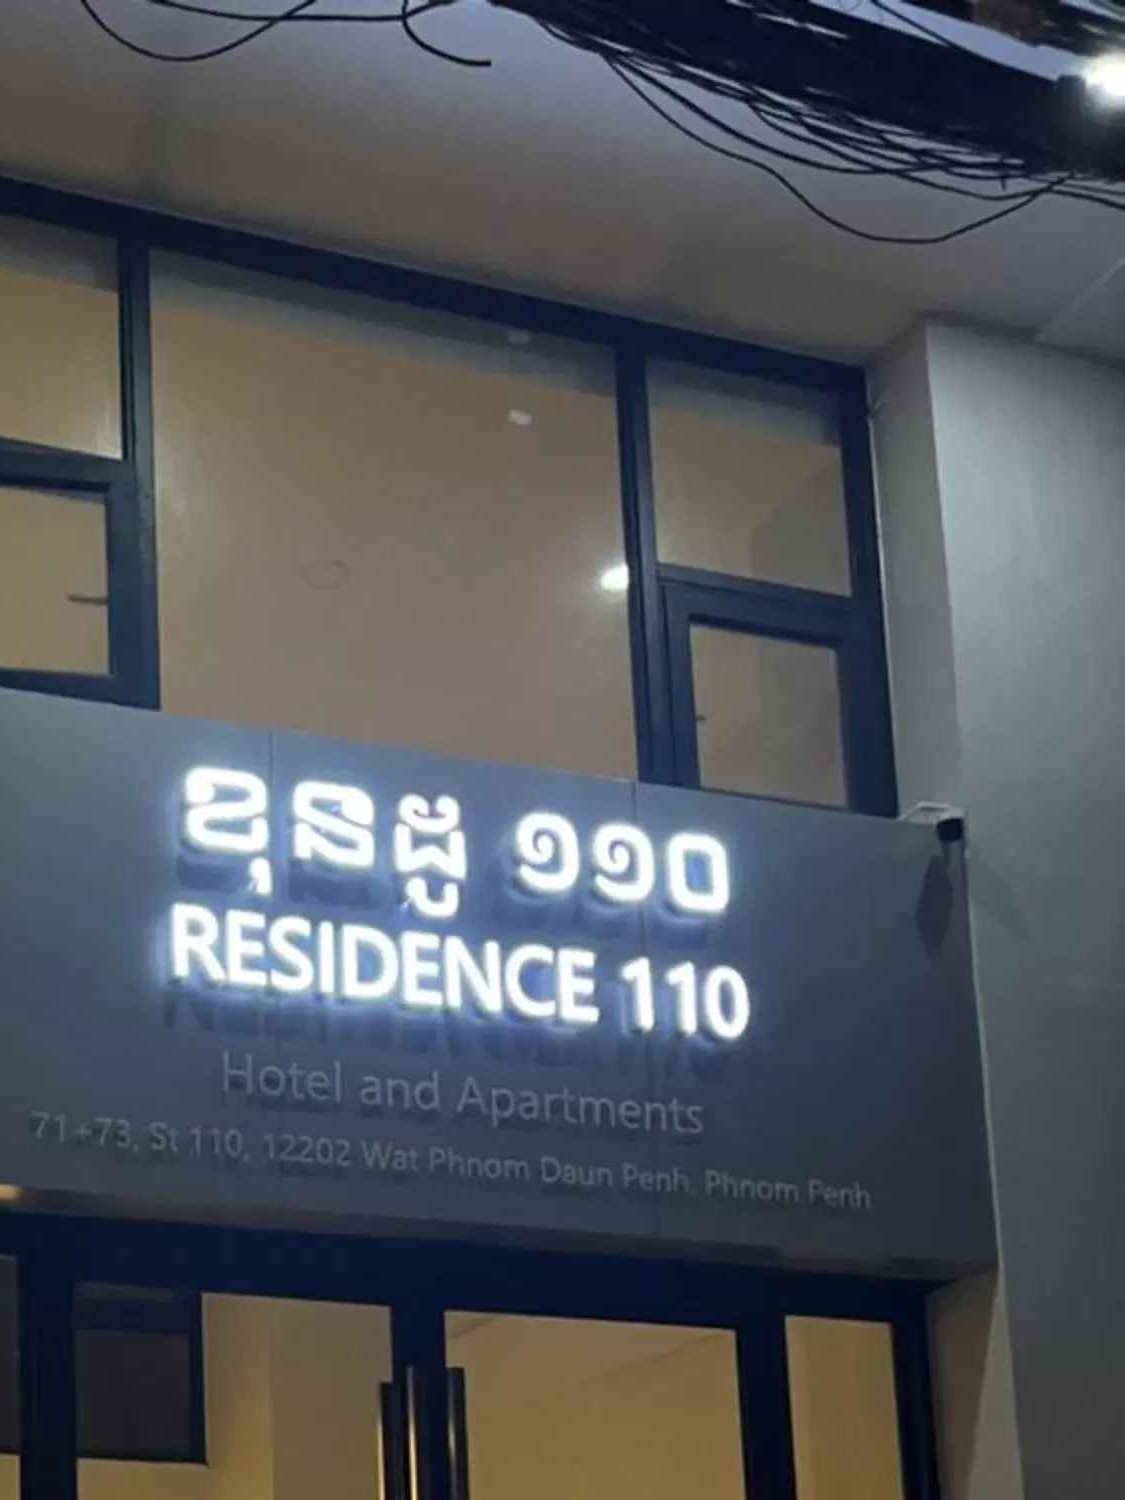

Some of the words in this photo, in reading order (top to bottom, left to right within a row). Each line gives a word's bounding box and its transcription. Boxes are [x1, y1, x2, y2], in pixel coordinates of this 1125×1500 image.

[172, 903, 599, 1021] RESIDENCE
[621, 957, 749, 1037] 110
[222, 1050, 342, 1103] Hotel
[360, 1070, 441, 1111] and
[456, 1075, 705, 1135] Apartments
[149, 1121, 180, 1153] St
[189, 1128, 249, 1161] 110,
[264, 1133, 351, 1168] 12202
[360, 1142, 421, 1172] Wat
[428, 1146, 531, 1182] Phnom
[540, 1157, 613, 1188] Daun
[705, 1169, 800, 1204] Phnom
[809, 1179, 872, 1210] Penh
